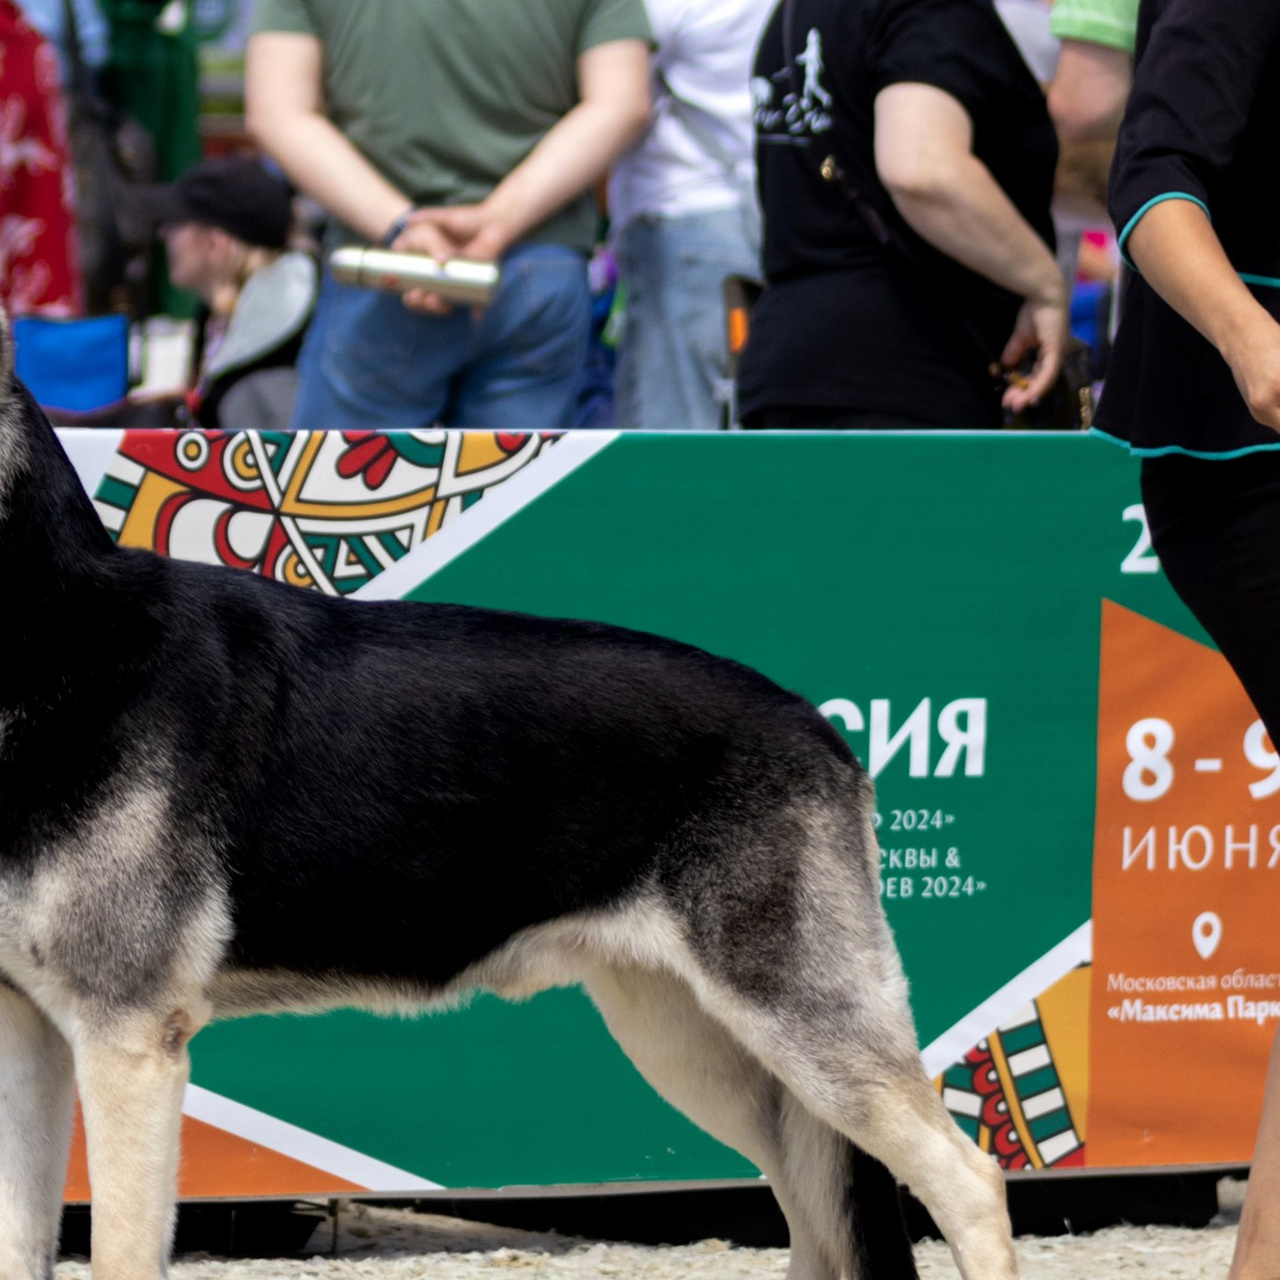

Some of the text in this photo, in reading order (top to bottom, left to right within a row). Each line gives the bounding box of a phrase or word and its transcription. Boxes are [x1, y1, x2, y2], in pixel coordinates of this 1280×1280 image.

[1122, 718, 1175, 802] 8
[945, 847, 961, 868] &
[921, 876, 986, 898] 2024»
[1107, 973, 1217, 991] Московская
